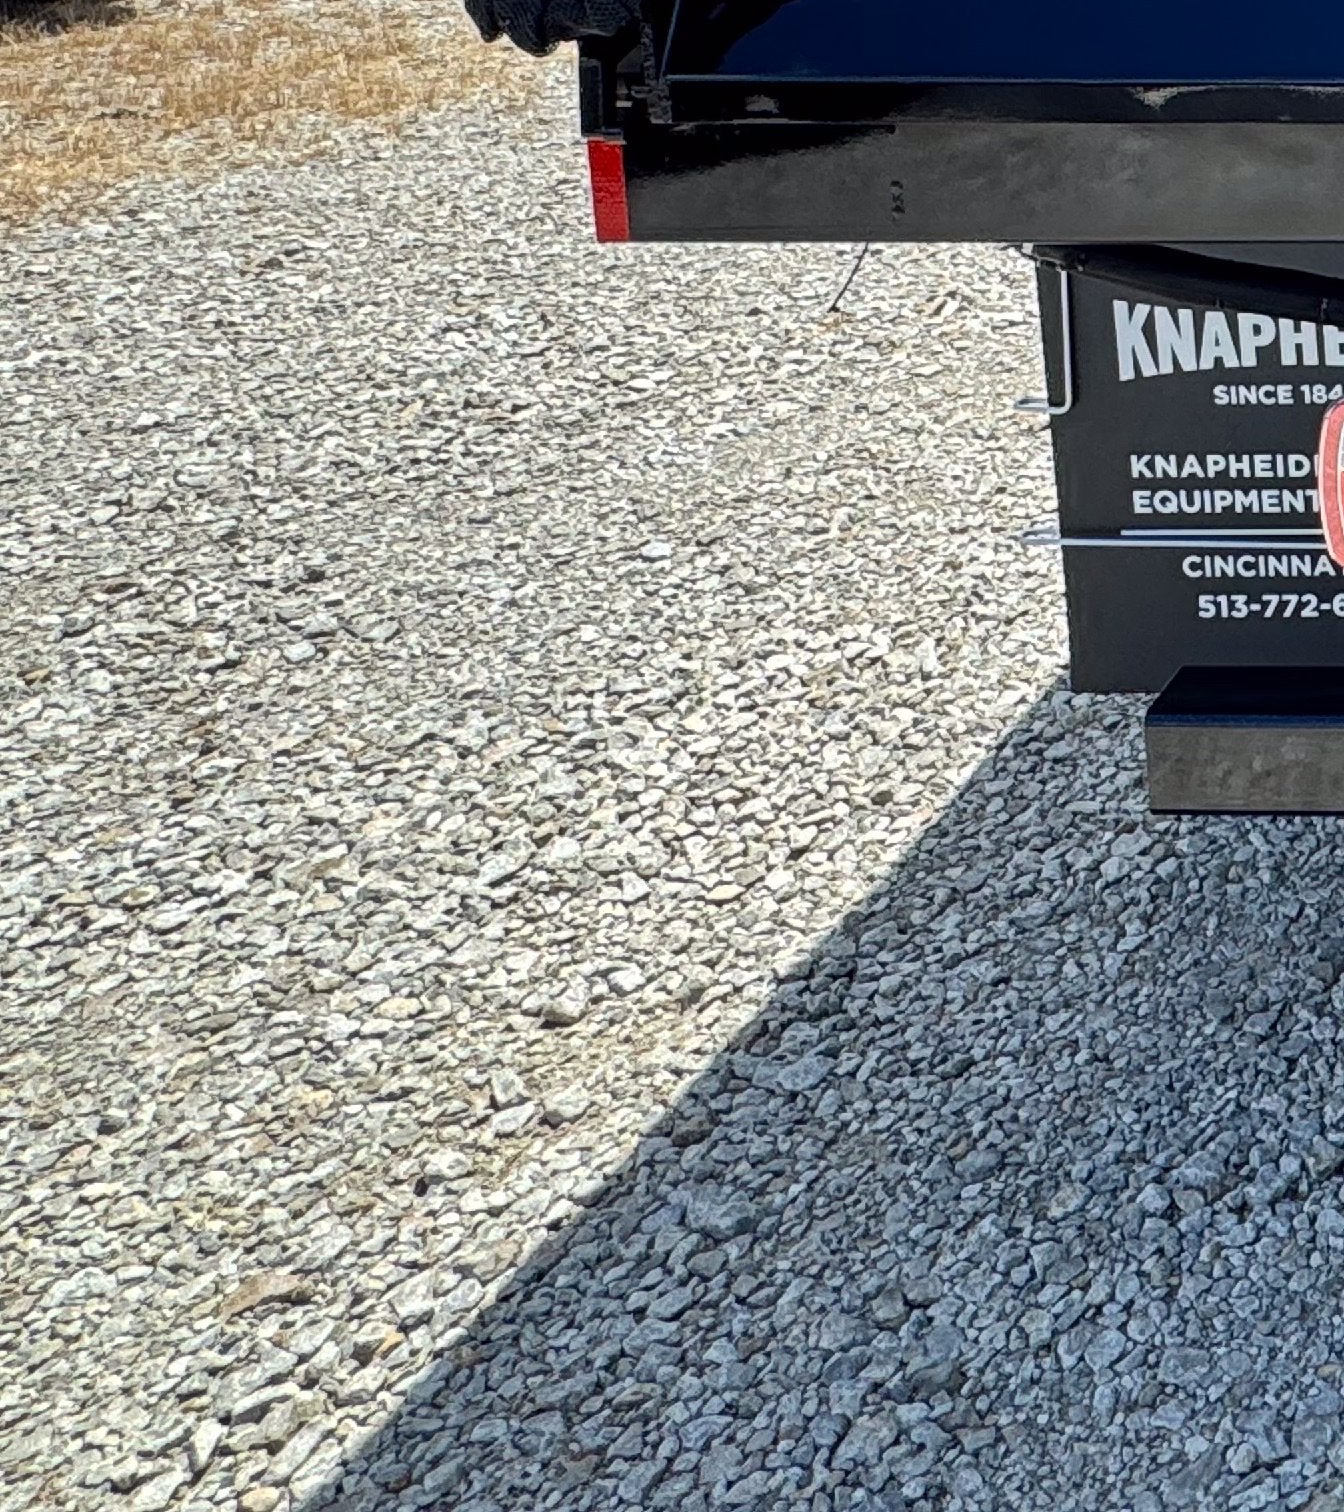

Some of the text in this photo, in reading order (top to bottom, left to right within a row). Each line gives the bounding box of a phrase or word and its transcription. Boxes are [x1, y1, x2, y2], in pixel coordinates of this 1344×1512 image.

[1212, 384, 1294, 406] SINCE
[1130, 453, 1319, 479] KNAPHEID
[1132, 488, 1320, 515] EQUIPMENT
